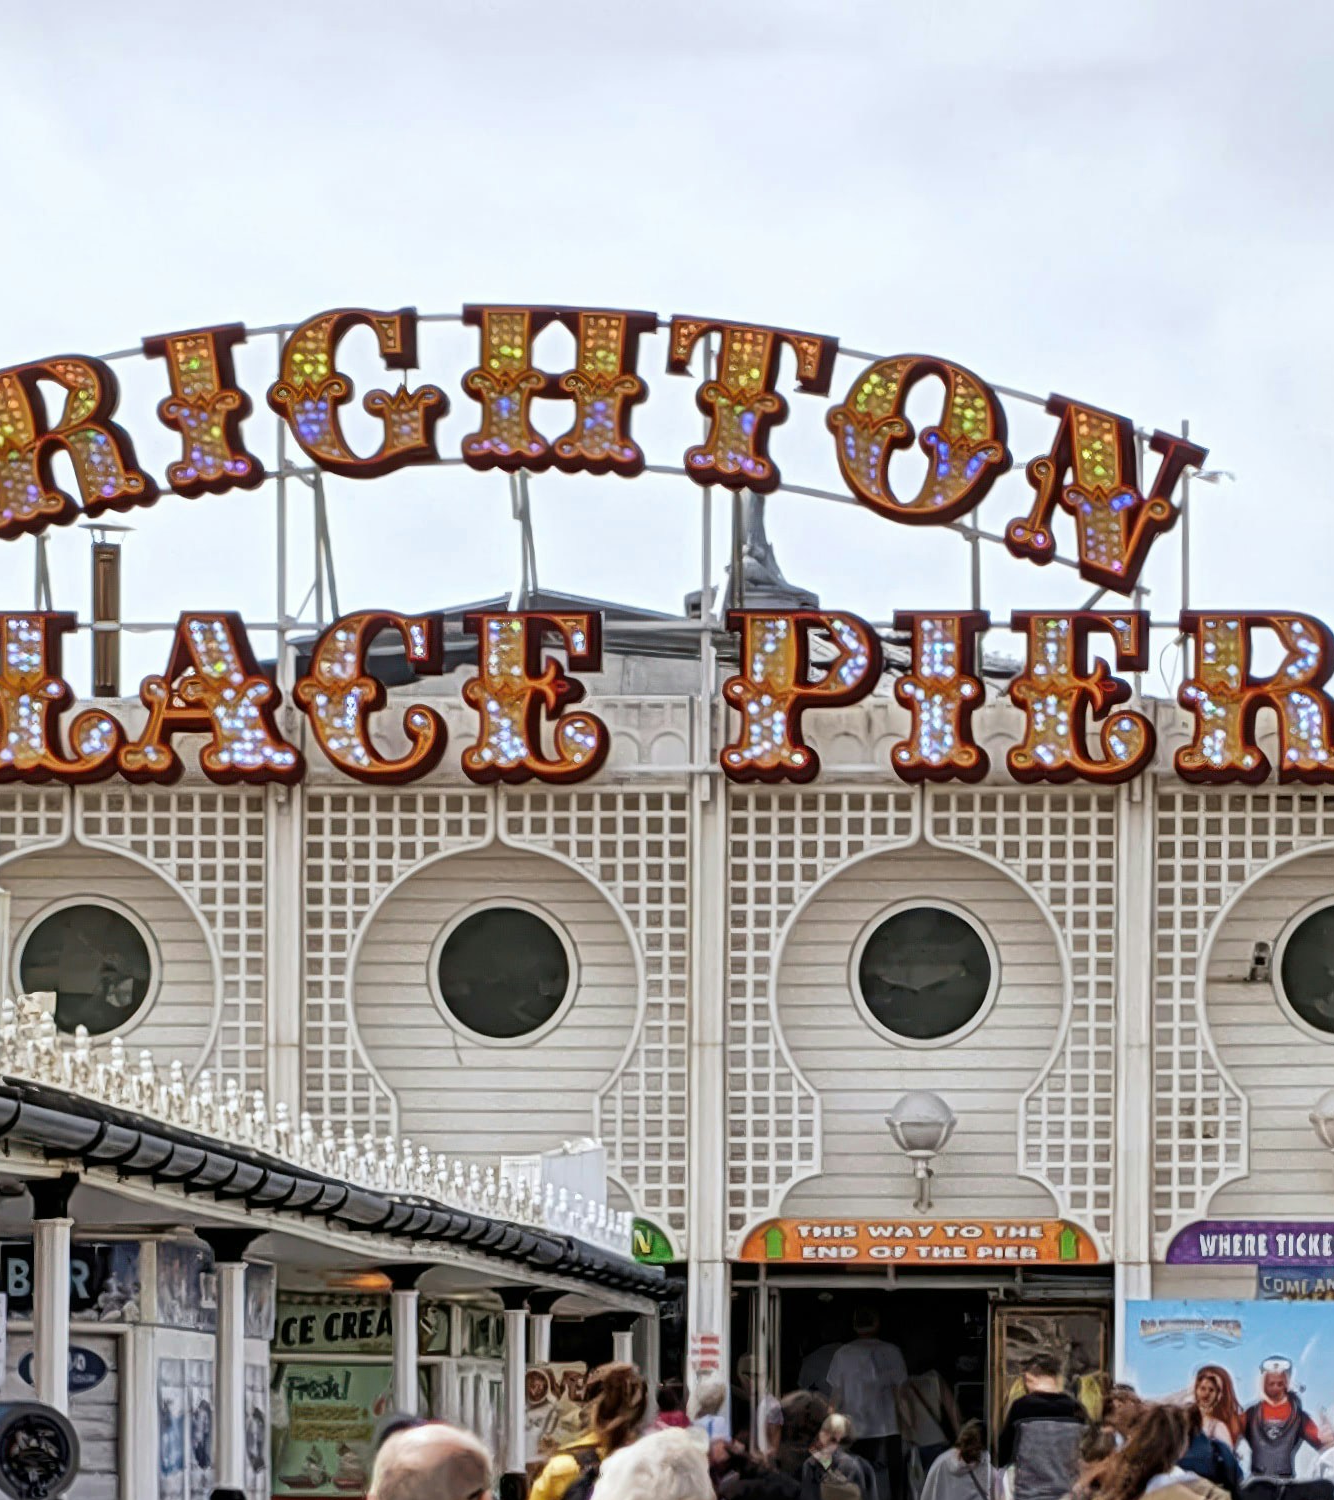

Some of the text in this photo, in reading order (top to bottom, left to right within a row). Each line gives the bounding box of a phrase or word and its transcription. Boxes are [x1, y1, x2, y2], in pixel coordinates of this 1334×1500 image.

[797, 1225, 1045, 1240] THIS WAY TO THE
[1199, 1232, 1267, 1257] WHERE
[801, 1245, 1040, 1260] END OF THE PIER
[6, 1256, 92, 1300] BR
[323, 1307, 395, 1343] CREA
